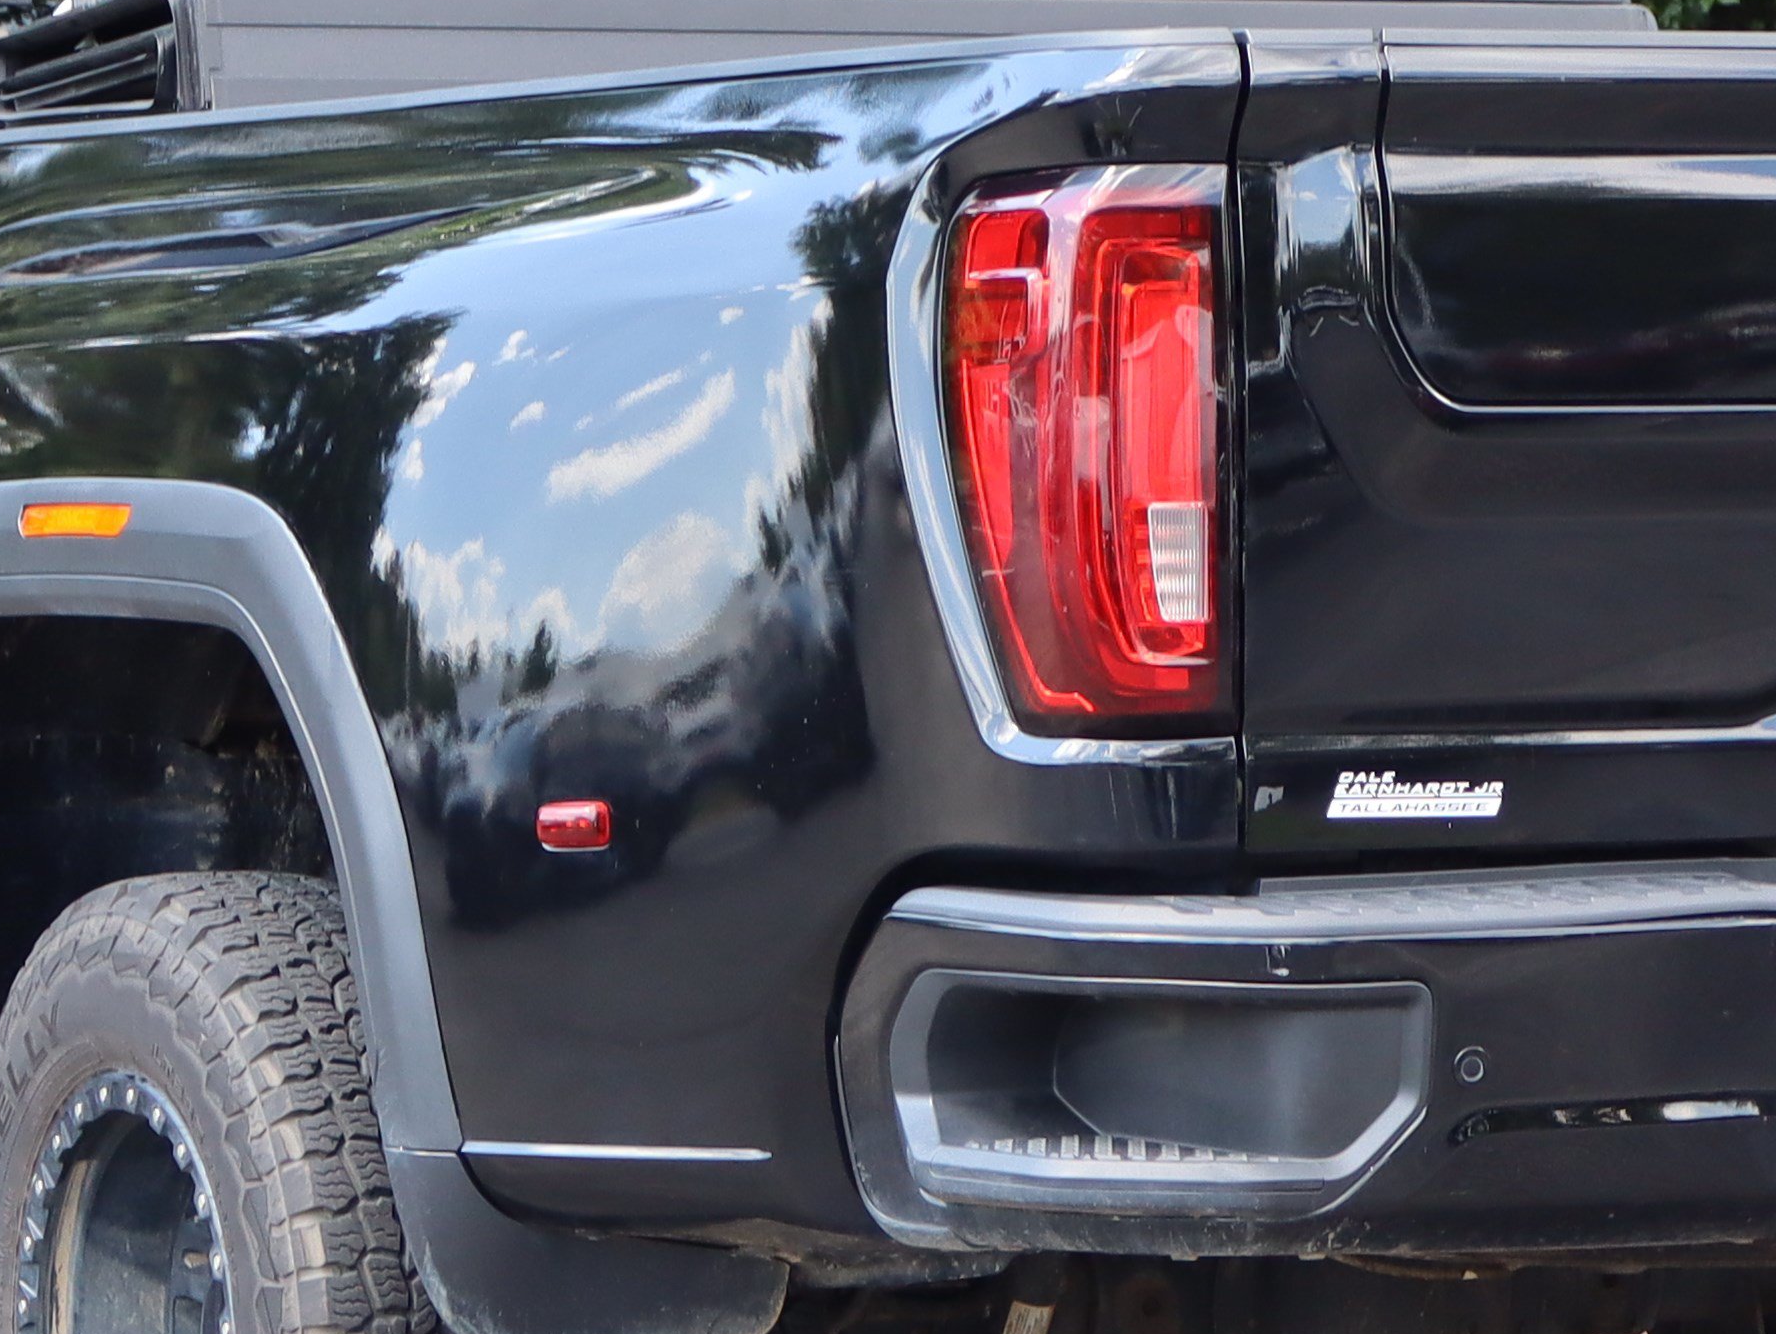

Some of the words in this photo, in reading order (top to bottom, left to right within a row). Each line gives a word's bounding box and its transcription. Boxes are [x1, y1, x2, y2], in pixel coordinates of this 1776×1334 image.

[1338, 770, 1395, 783] DALE
[1334, 782, 1471, 798] EARNHARDT
[1474, 781, 1504, 798] JR
[1339, 803, 1488, 813] TALLAHASSEE
